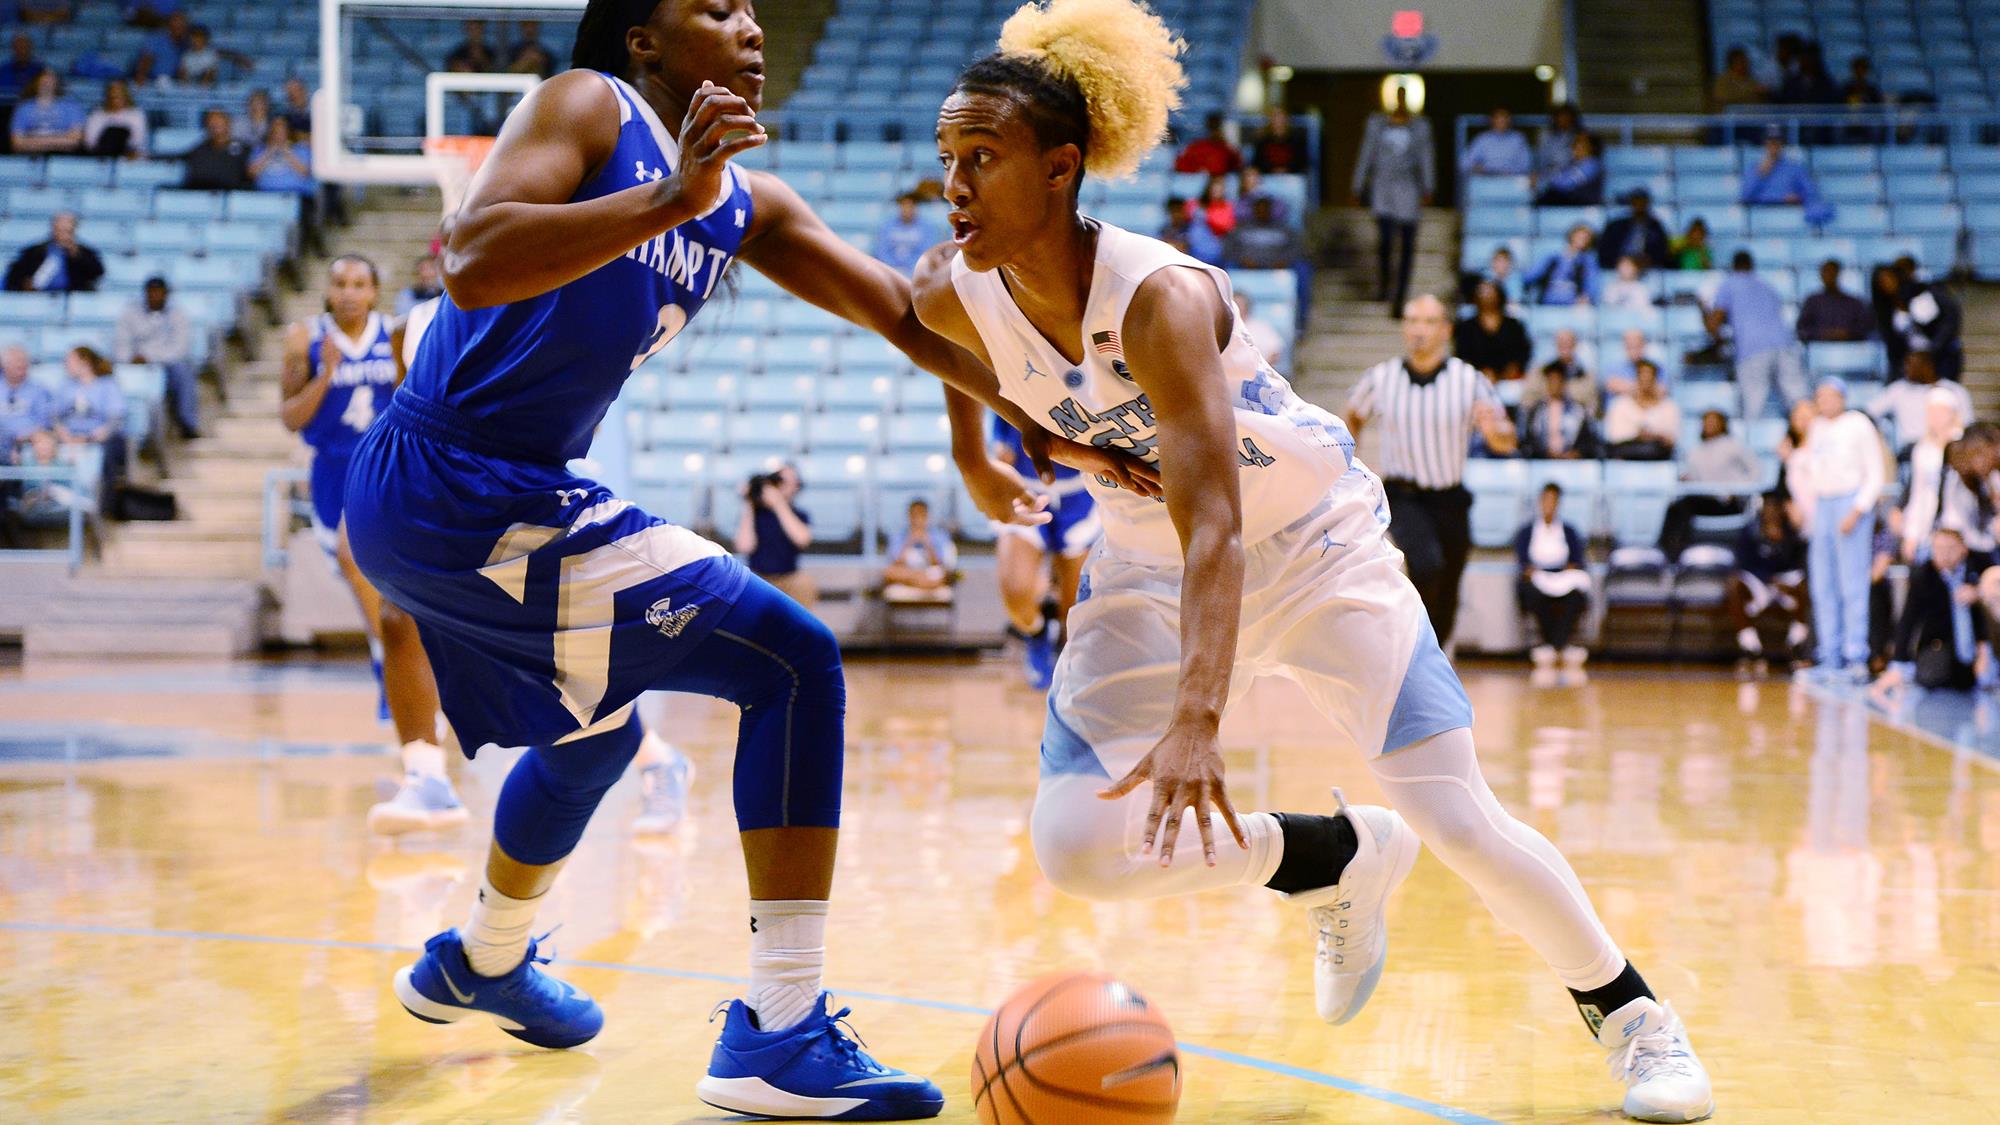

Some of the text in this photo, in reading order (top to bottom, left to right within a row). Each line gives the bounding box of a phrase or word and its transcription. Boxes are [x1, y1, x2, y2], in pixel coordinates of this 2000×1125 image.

[626, 228, 734, 301] AMPT
[331, 359, 398, 387] AMPTON
[340, 384, 377, 434] 4
